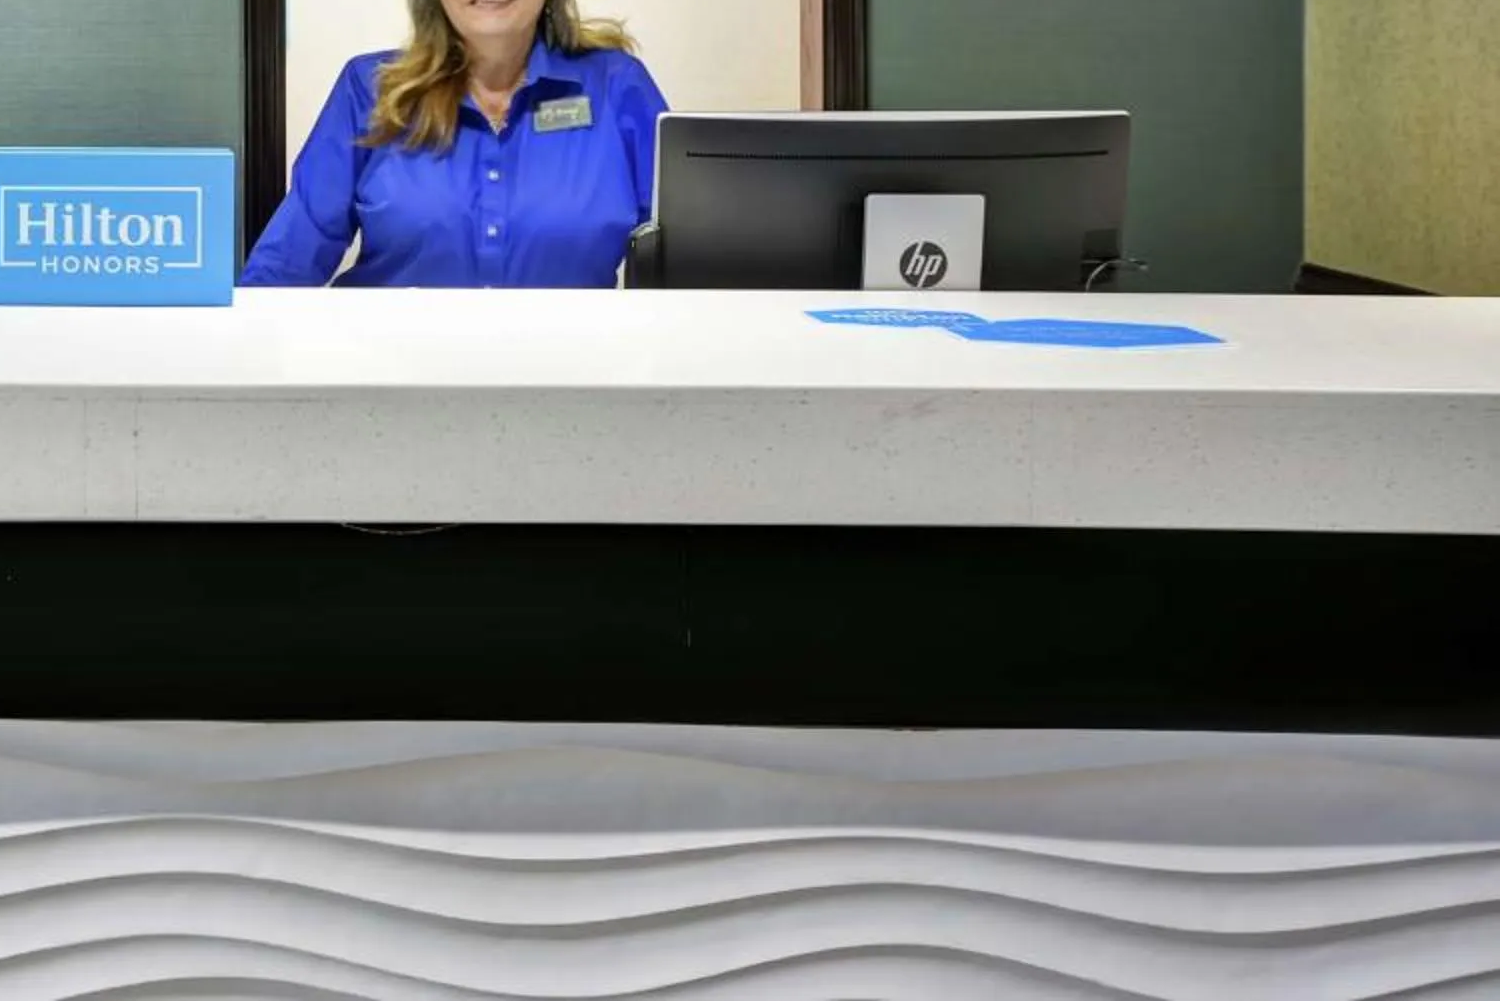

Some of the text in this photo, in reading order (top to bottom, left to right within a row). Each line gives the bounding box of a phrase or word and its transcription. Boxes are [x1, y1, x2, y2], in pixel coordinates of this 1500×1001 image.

[16, 202, 184, 247] Hilton
[42, 255, 160, 274] HONORS
[905, 240, 943, 287] hp
